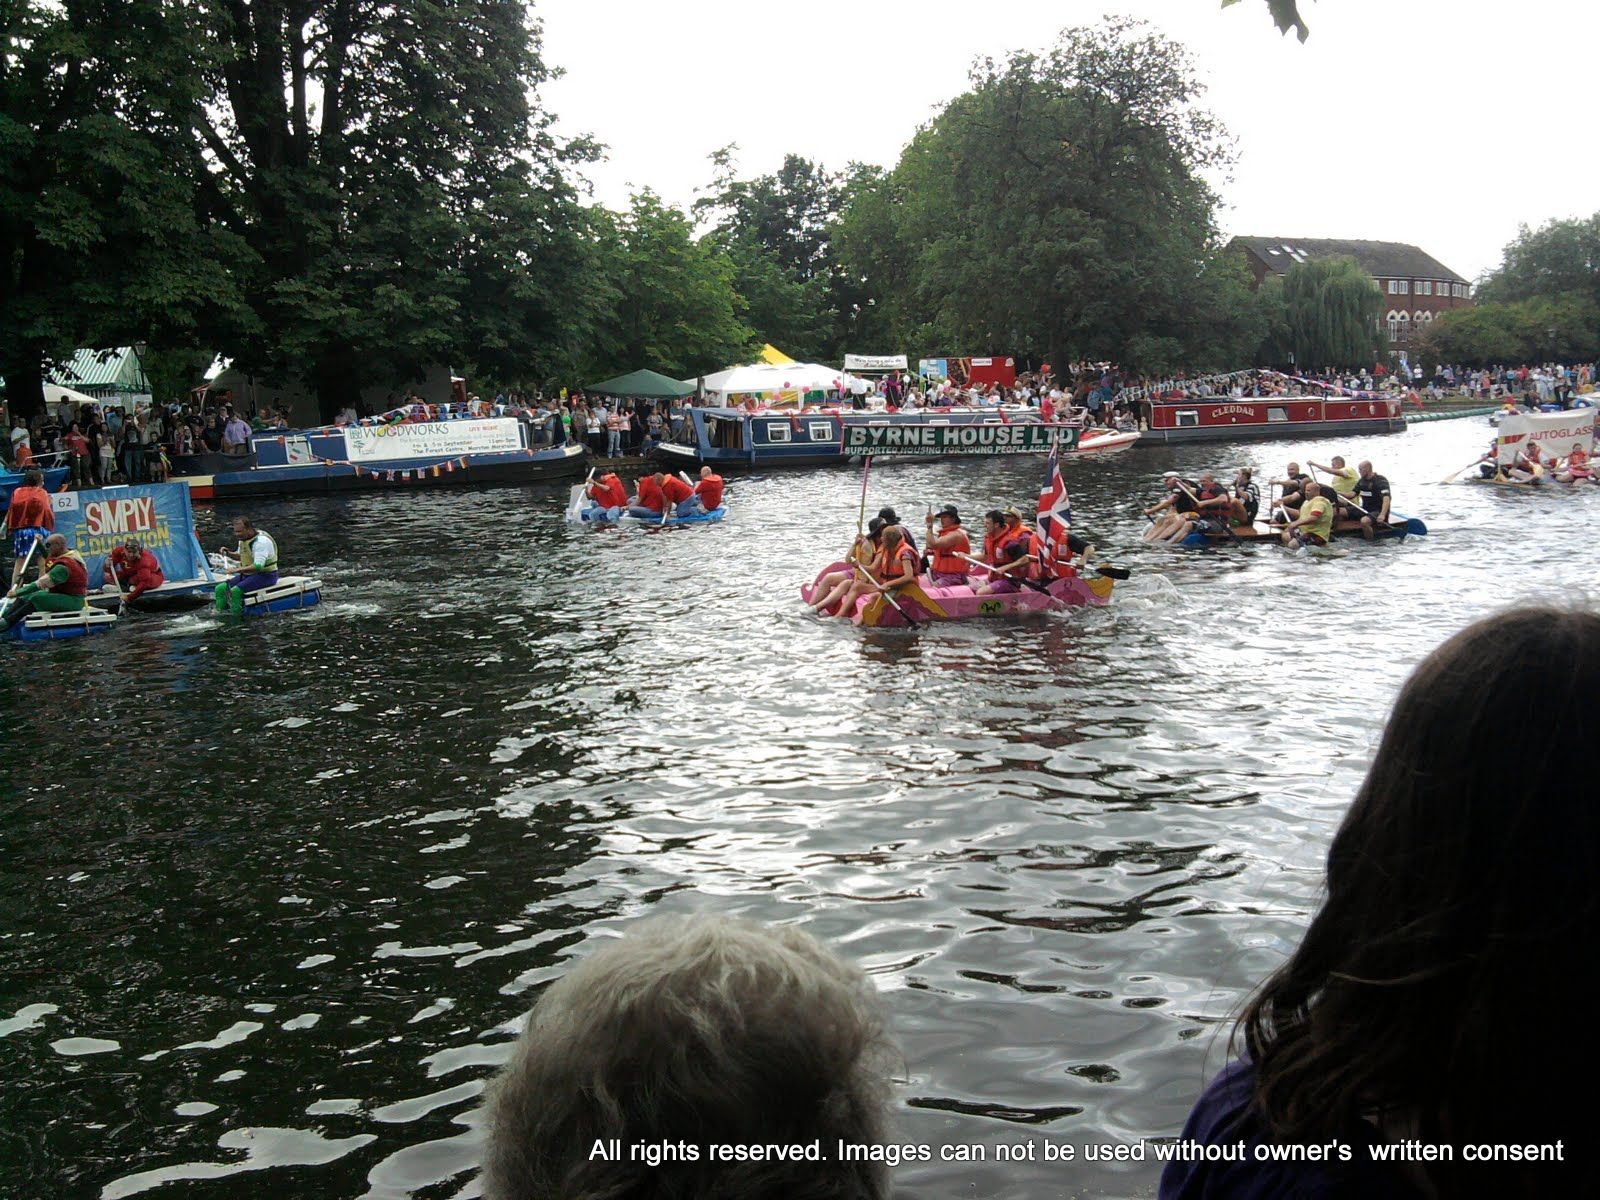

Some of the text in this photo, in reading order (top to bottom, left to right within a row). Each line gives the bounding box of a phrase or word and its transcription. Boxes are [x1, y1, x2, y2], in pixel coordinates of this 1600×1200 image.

[850, 425, 1074, 446] BYRNE HOUSE LTD
[1529, 425, 1594, 441] AUTOGLASS
[844, 446, 898, 455] SUPPORTED
[900, 446, 941, 454] HOUSING
[943, 445, 961, 454] FOR
[963, 445, 994, 454] YOUNG
[995, 445, 1028, 454] PEOPLE
[58, 498, 72, 508] 62
[85, 497, 152, 536] SIMPLY
